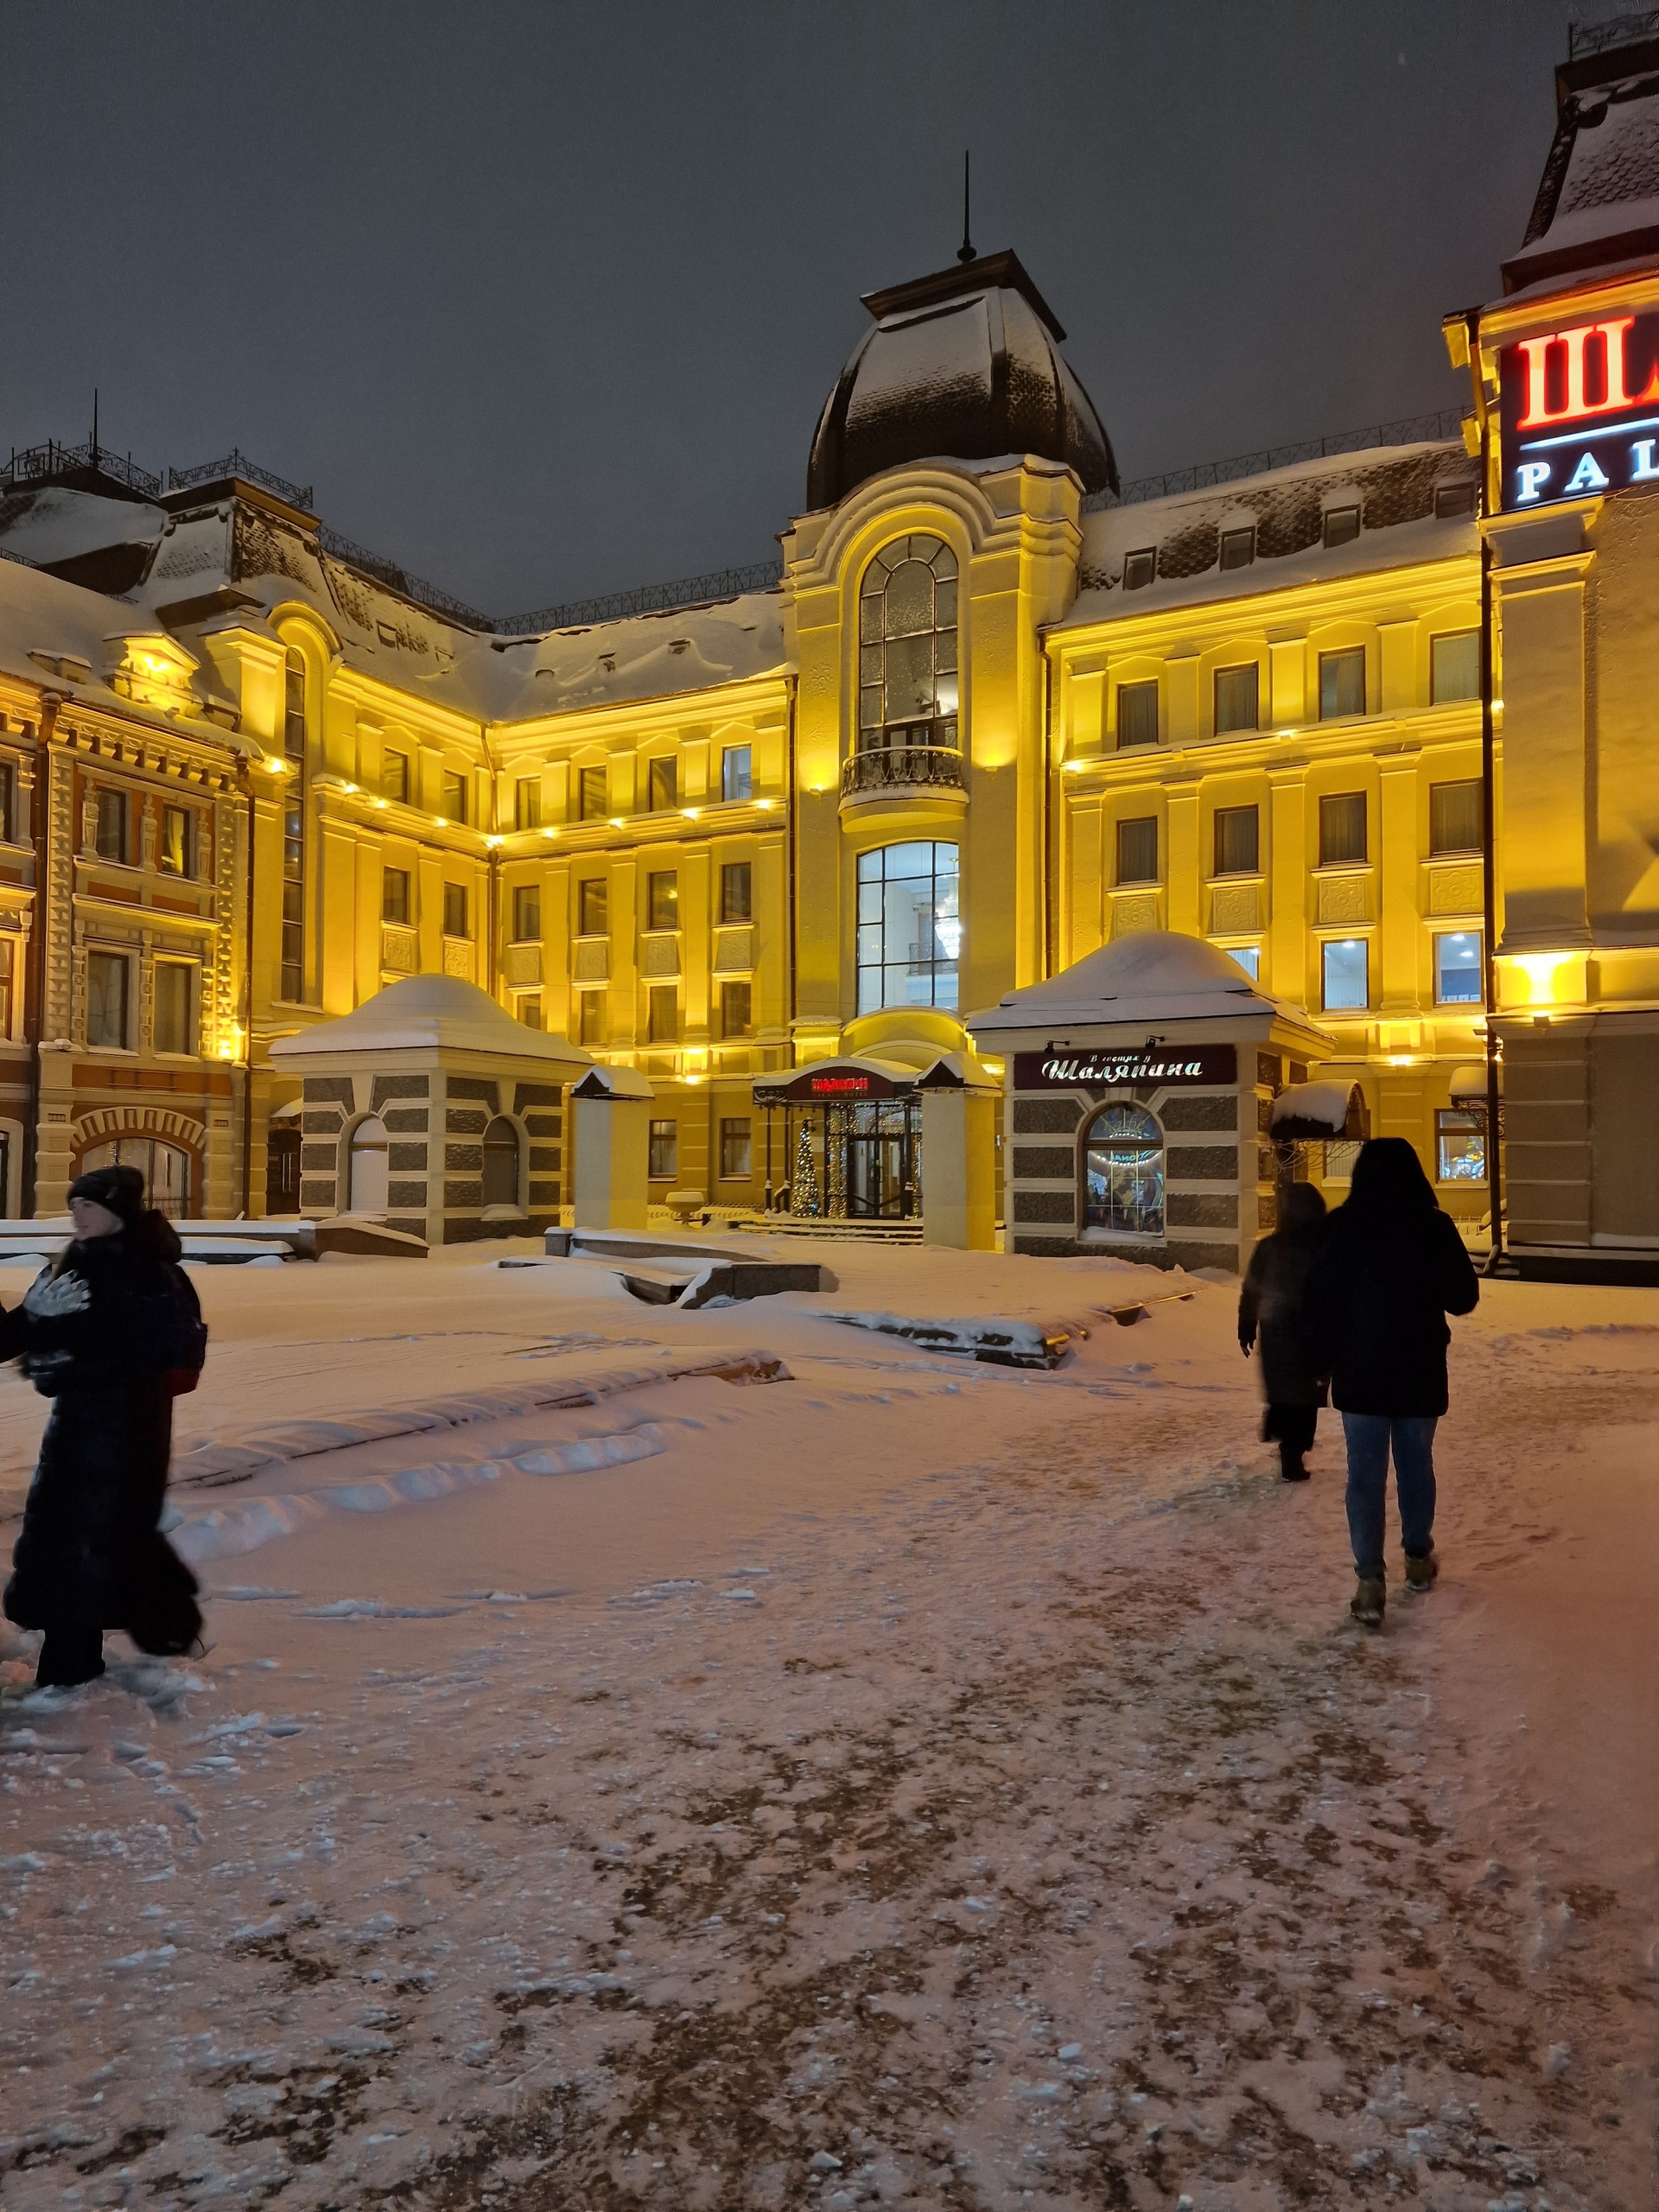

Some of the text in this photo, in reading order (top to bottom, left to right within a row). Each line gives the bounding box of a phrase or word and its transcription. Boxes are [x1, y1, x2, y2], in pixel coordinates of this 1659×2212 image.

[1089, 1054, 1098, 1063] В
[1102, 1055, 1141, 1064] гостях
[1041, 1058, 1204, 1084] Шаляпина
